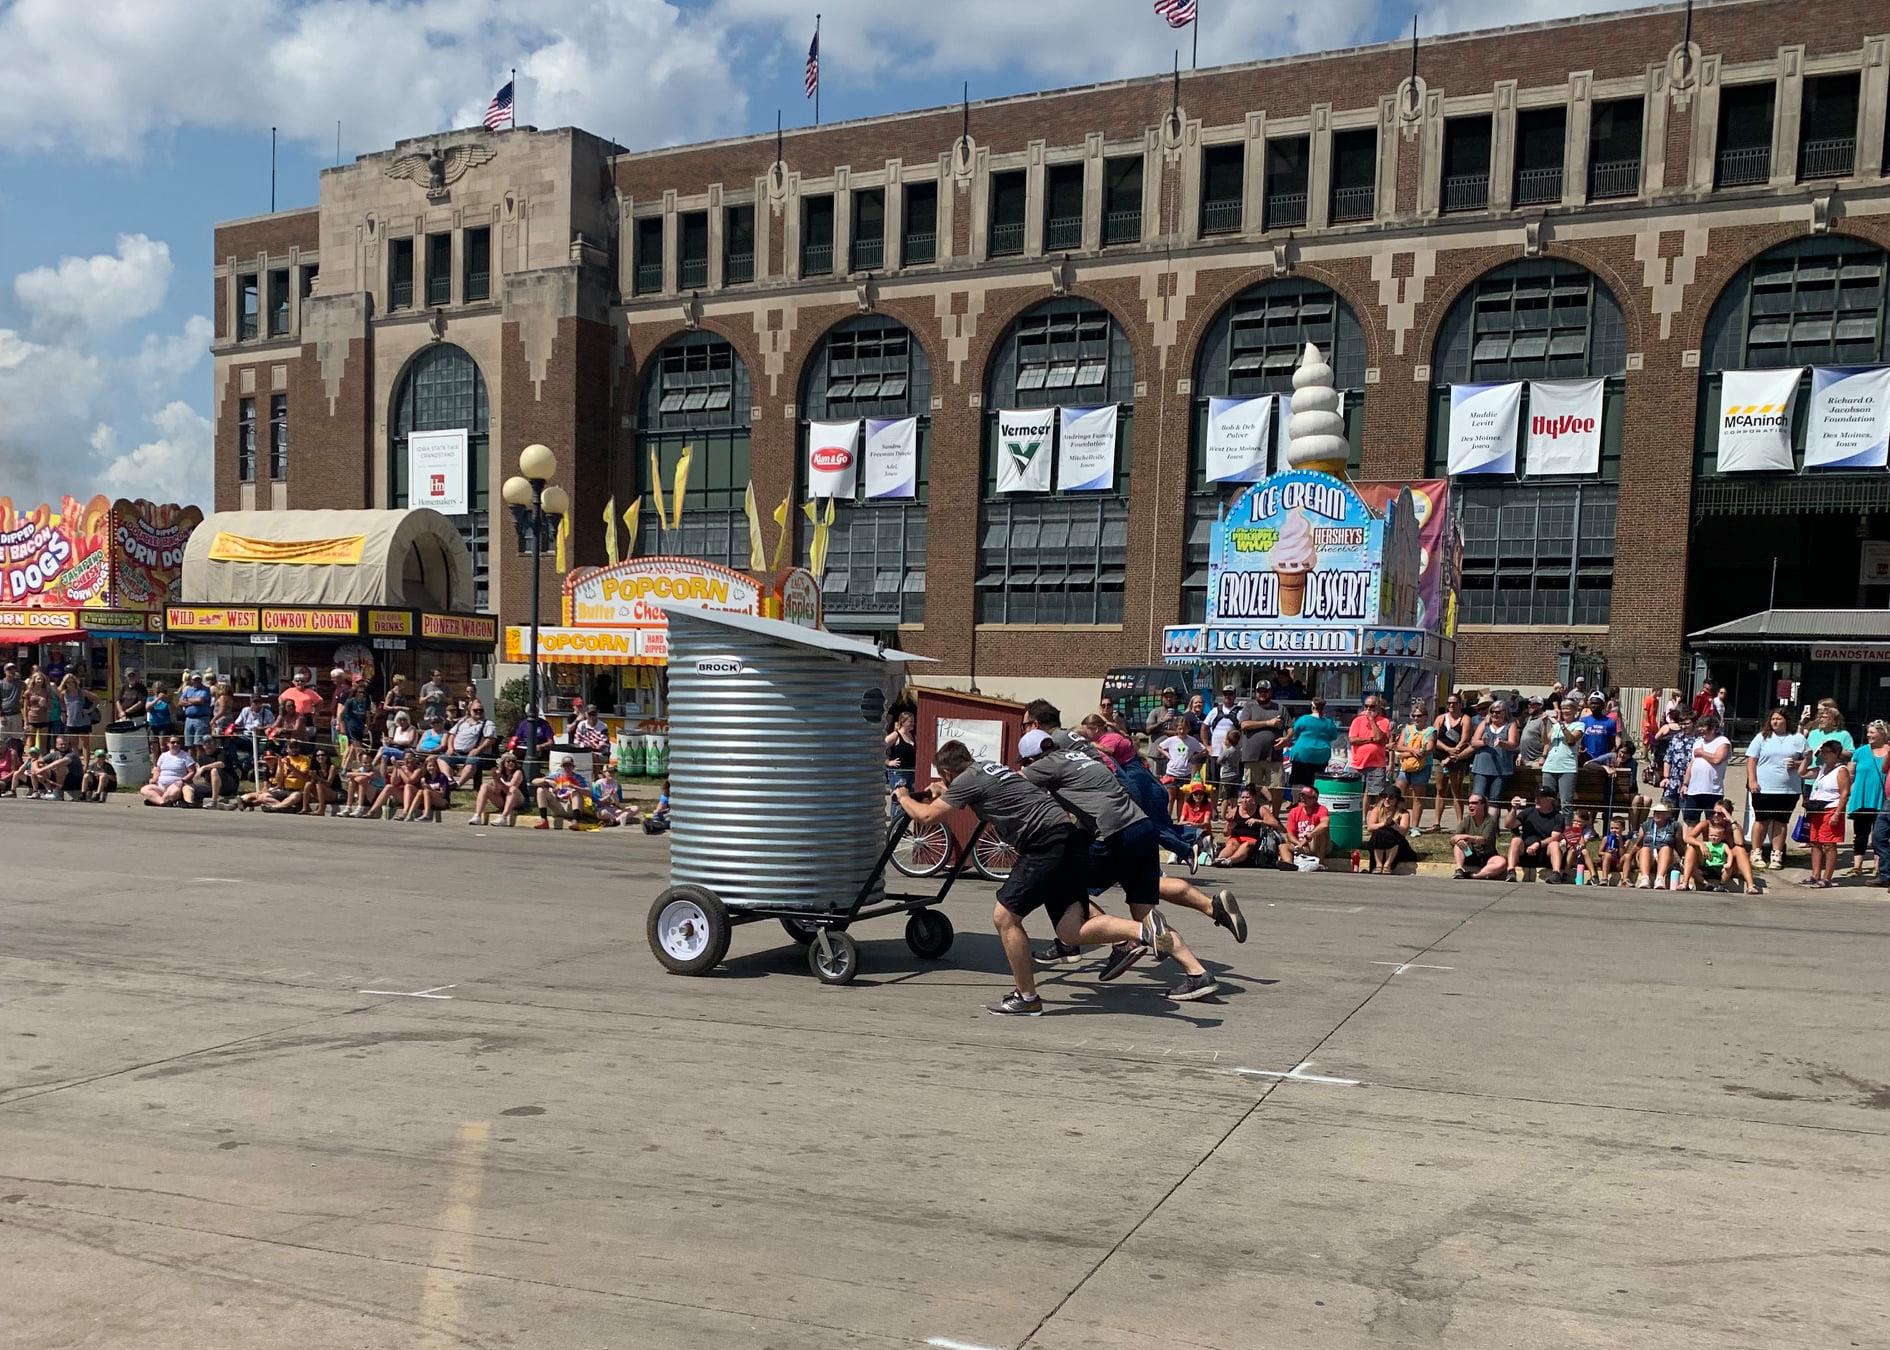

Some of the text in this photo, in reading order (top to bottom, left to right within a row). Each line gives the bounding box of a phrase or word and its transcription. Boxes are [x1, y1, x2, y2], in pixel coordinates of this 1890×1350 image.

[1828, 396, 1876, 404] Richard O.
[1242, 423, 1256, 431] Deb
[1532, 415, 1595, 440] HyVee
[1823, 415, 1875, 423] Foundation
[1001, 424, 1051, 436] Vermeer
[1839, 432, 1873, 440] Moines,
[1070, 440, 1106, 448] Foundation
[1250, 482, 1346, 521] ICE CREAM
[1, 523, 35, 544] DIPPED
[1231, 532, 1279, 541] PINEAPPLE
[1314, 528, 1363, 544] HERSHEY'S
[10, 526, 52, 560] BACON
[117, 527, 157, 567] CORN
[1237, 540, 1273, 552] WHIP
[10, 531, 69, 597] DOGS
[67, 561, 109, 600] CORN DOGS
[602, 576, 729, 603] POPCORN
[1218, 569, 1370, 620] FROZEN DESSERT
[169, 609, 195, 627] WILD
[227, 611, 256, 627] WEST
[577, 602, 616, 620] Butter
[785, 594, 815, 624] Apples
[29, 613, 71, 627] DOGS
[84, 615, 142, 627] Lemonade
[265, 611, 357, 630] COWBOY COOKIN'
[374, 622, 404, 632] DRINKS
[424, 615, 493, 638] PIONEER WAGON
[647, 634, 664, 644] HAND
[1217, 631, 1346, 650] ICE CREAM
[644, 644, 667, 654] DIPPED
